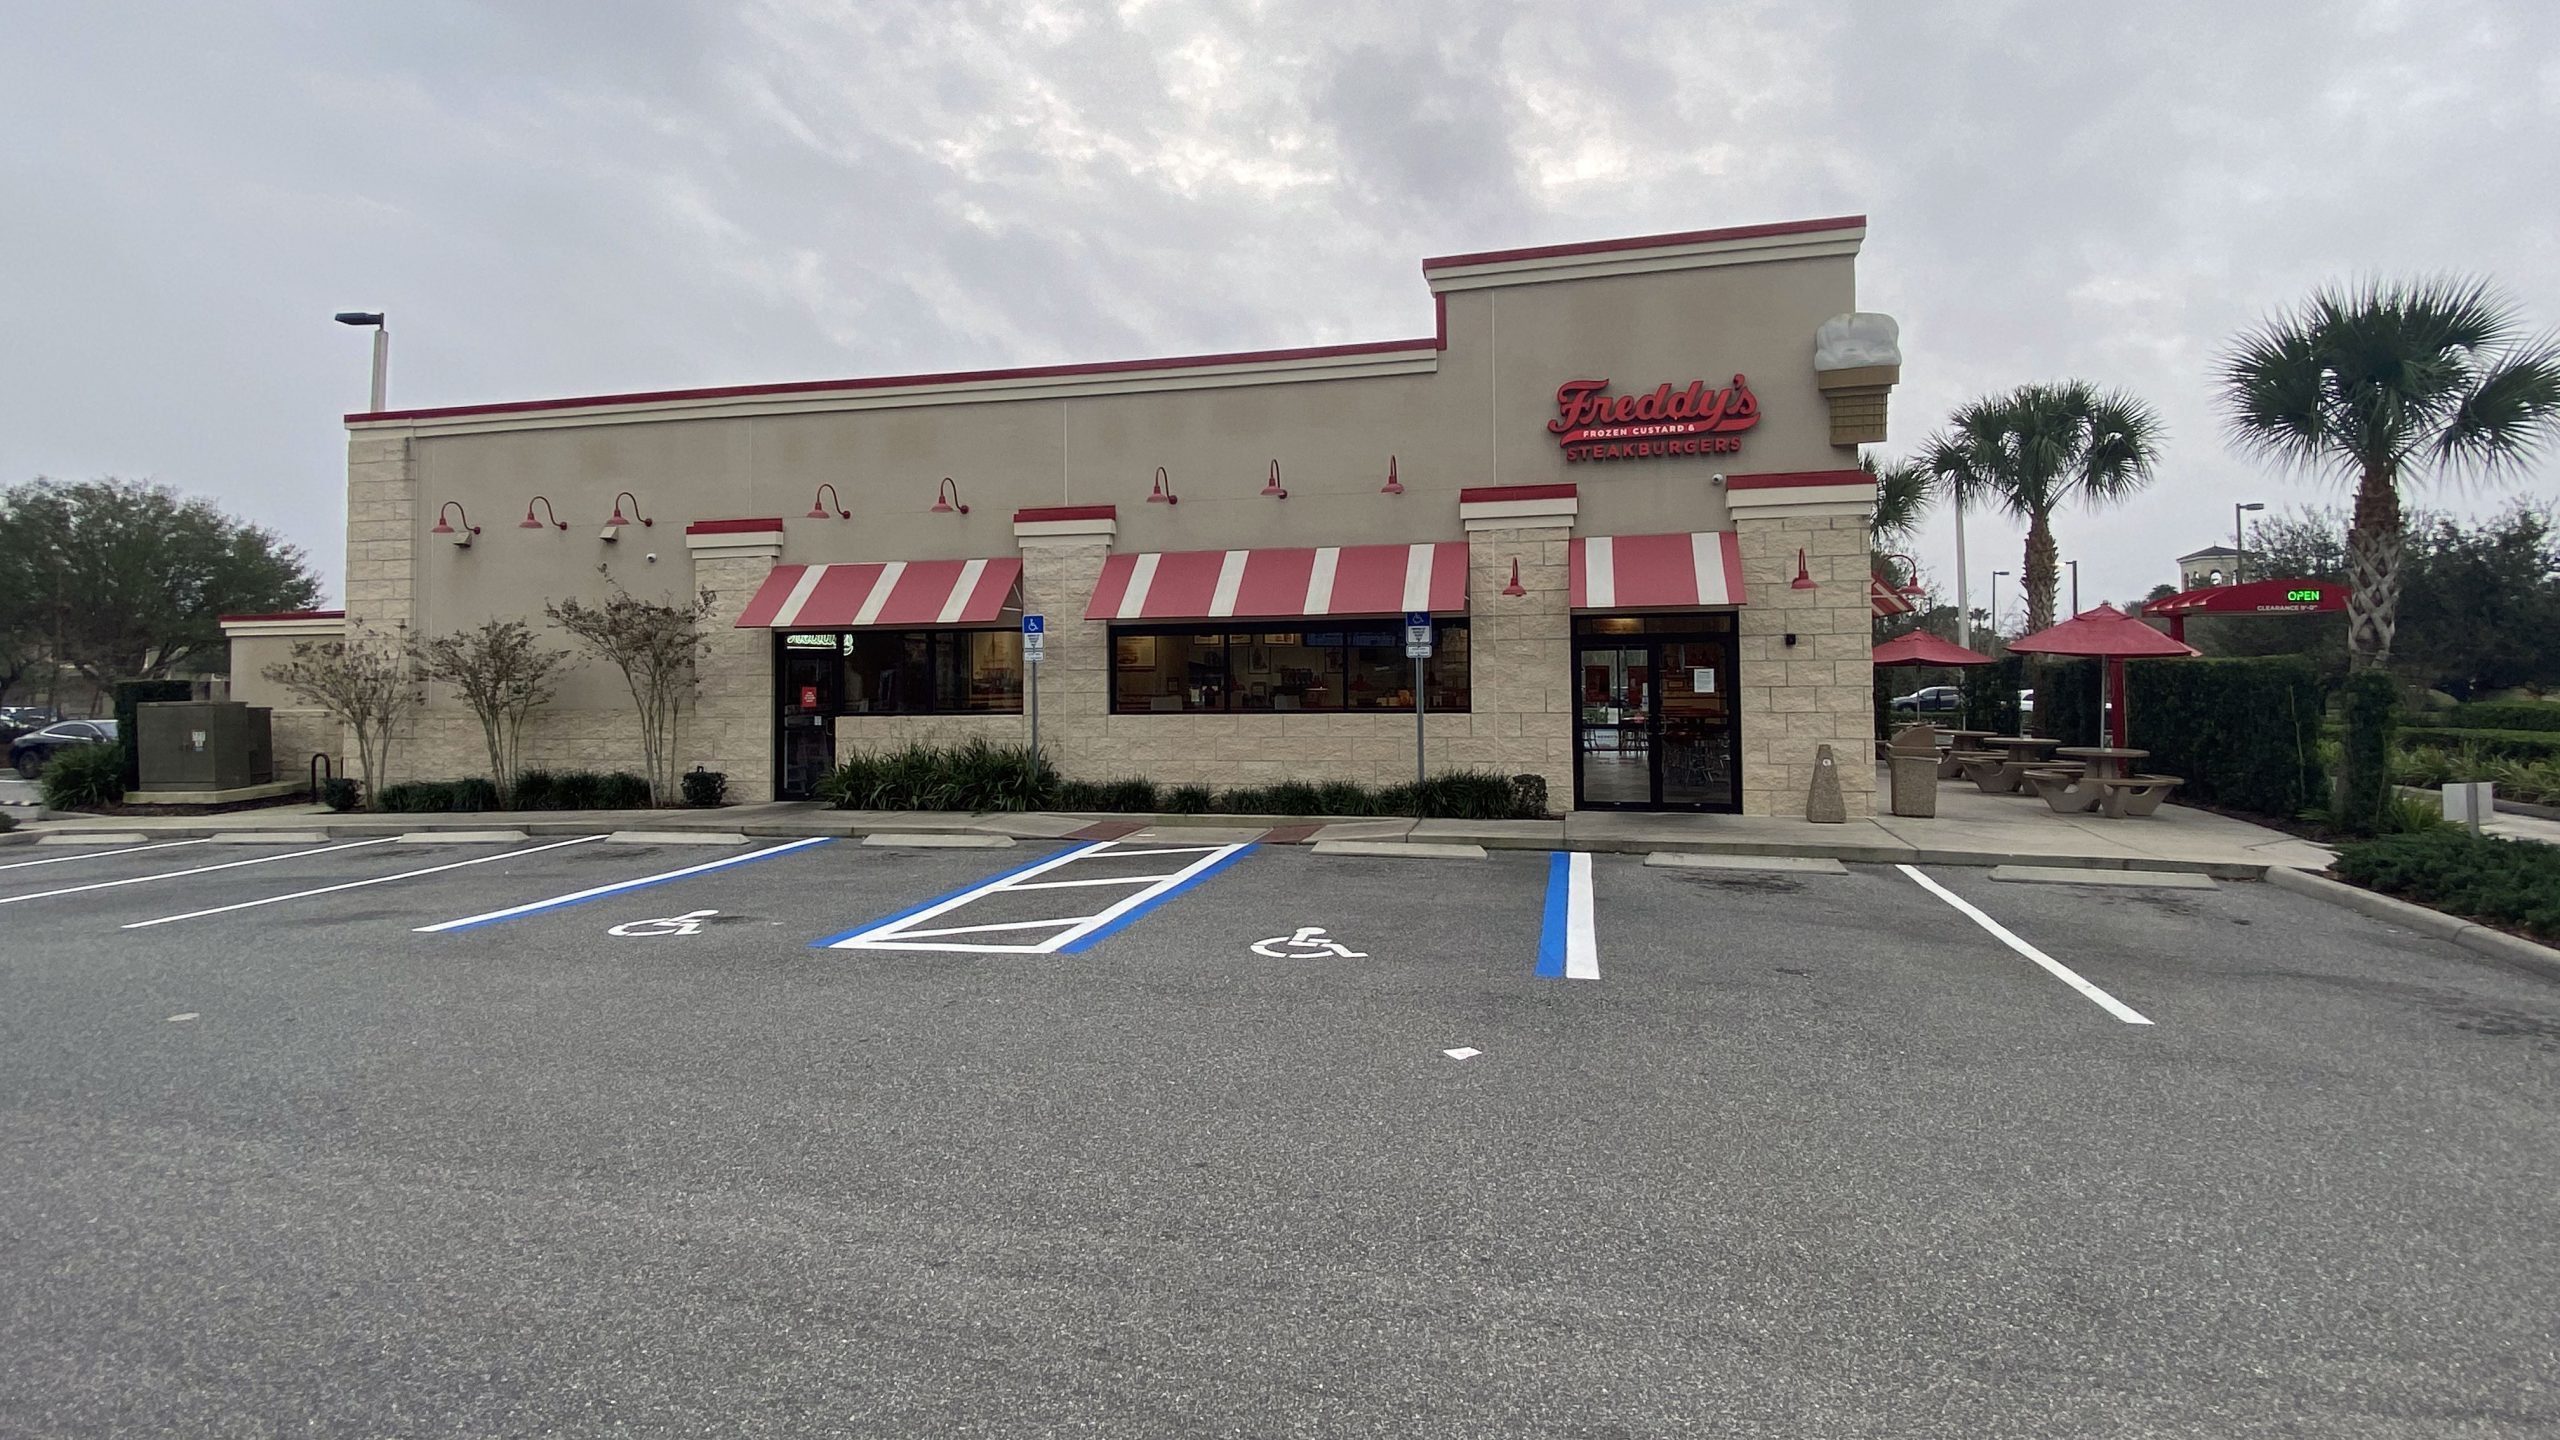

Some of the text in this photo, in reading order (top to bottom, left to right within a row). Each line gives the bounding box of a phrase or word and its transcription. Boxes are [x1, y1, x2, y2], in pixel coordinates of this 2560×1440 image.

[1547, 373, 1761, 437] Freddy's
[1583, 424, 1695, 438] FROZEN CUSTARD &
[1566, 436, 1742, 462] STEAKBURGERS
[2287, 590, 2320, 601] OPEN
